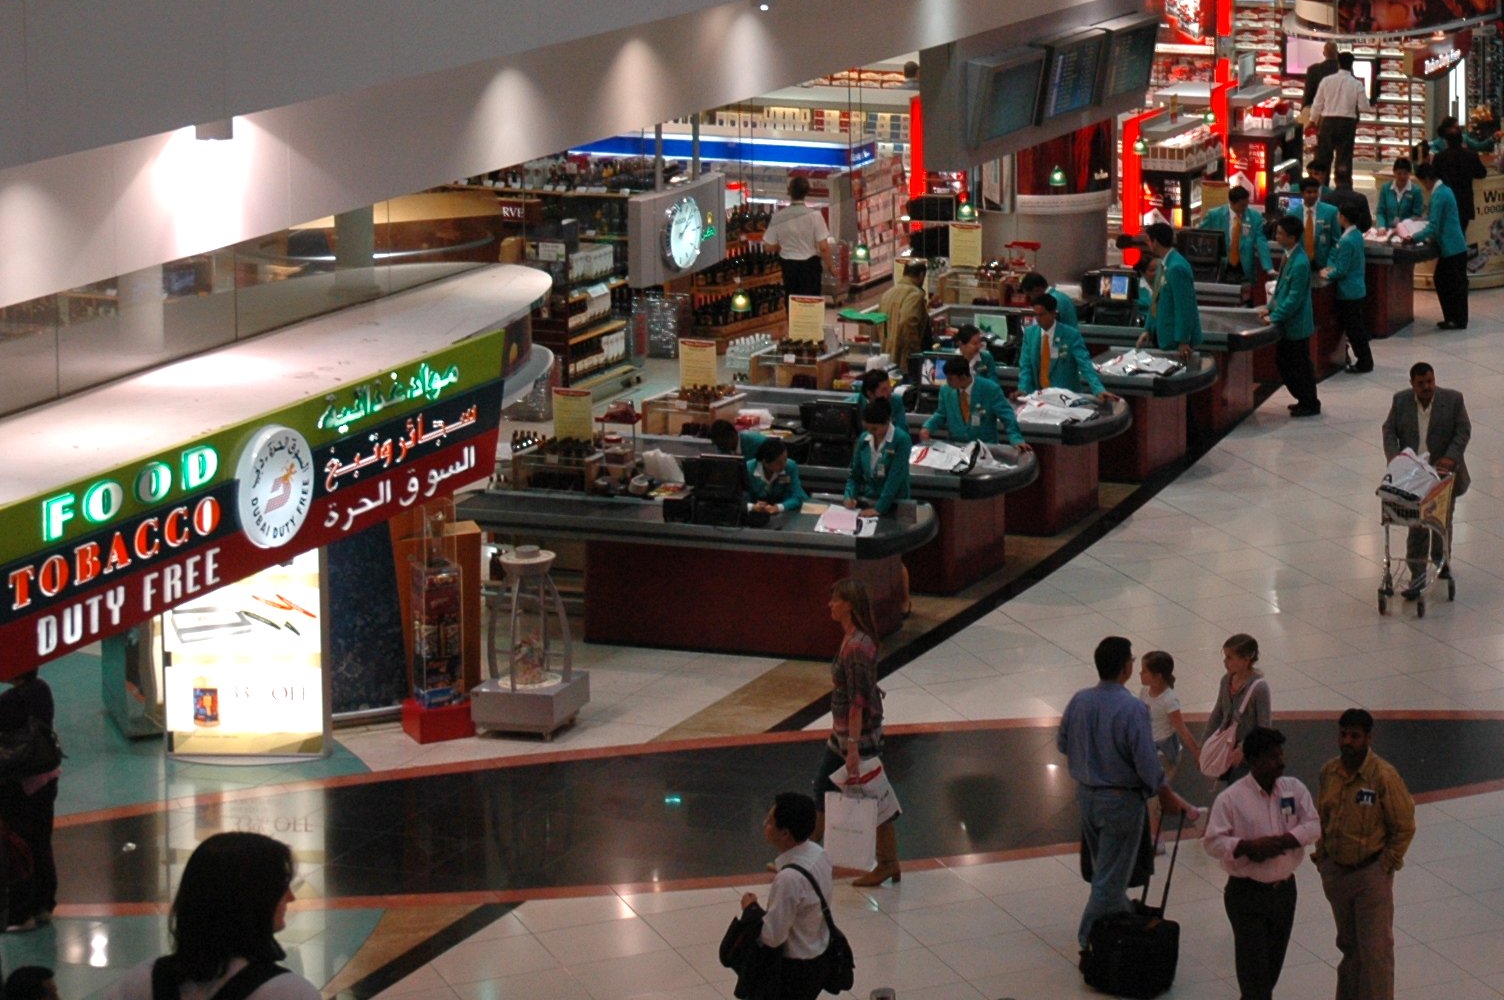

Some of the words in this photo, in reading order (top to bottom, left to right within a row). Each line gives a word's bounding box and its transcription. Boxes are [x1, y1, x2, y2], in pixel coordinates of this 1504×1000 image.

[41, 445, 219, 543] FOOD
[250, 496, 271, 537] DUBAI
[272, 516, 297, 540] DUTY
[296, 479, 310, 516] FREE
[323, 479, 393, 532] الحرة
[399, 444, 476, 507] السوق
[8, 495, 222, 611] TOBACCO
[37, 585, 125, 656] DUTY
[142, 547, 221, 613] FREE
